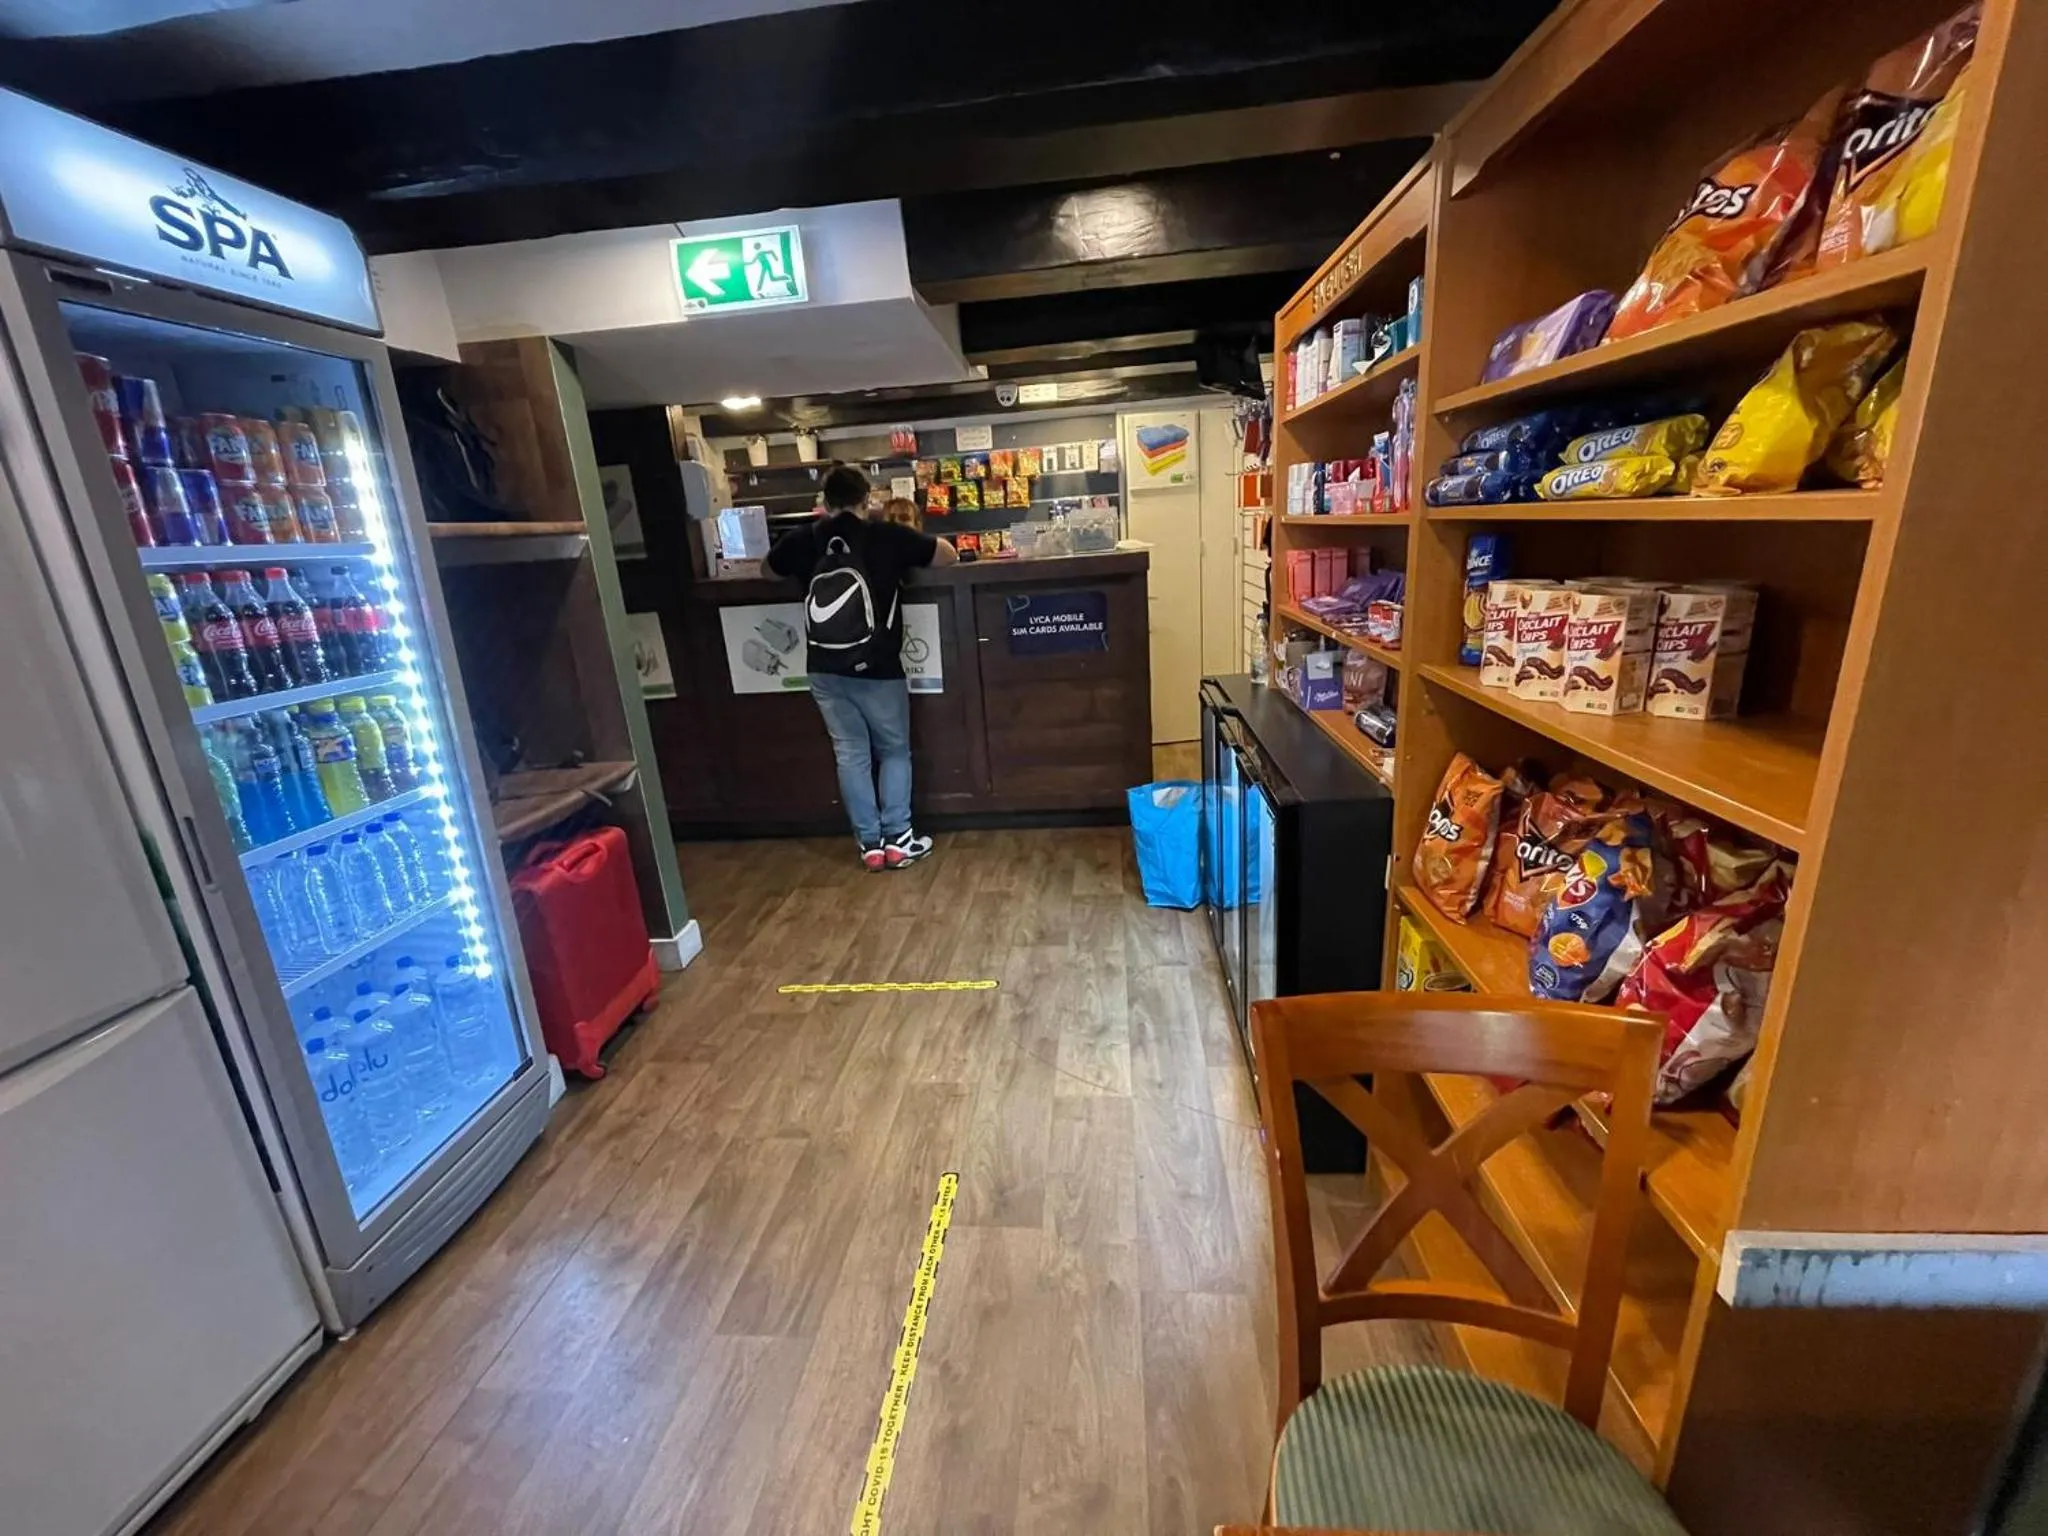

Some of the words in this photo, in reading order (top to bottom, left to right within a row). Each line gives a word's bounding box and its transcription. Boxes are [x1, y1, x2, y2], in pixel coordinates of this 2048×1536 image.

[149, 194, 294, 280] SPA
[1577, 426, 1636, 463] OREO
[1549, 465, 1605, 496] OREO
[1012, 627, 1028, 636] SIM
[1028, 625, 1057, 634] CARDS
[1058, 621, 1104, 633] AVAILABLE
[1028, 615, 1051, 625] LYCA
[1052, 612, 1084, 623] MOBILE
[929, 1229, 941, 1254] OTHER
[923, 1255, 934, 1277] EACH
[918, 1277, 929, 1302] FROM
[906, 1303, 923, 1347] DISTANCE
[900, 1350, 911, 1375] KEEP
[883, 1384, 904, 1443] TOGETHER
